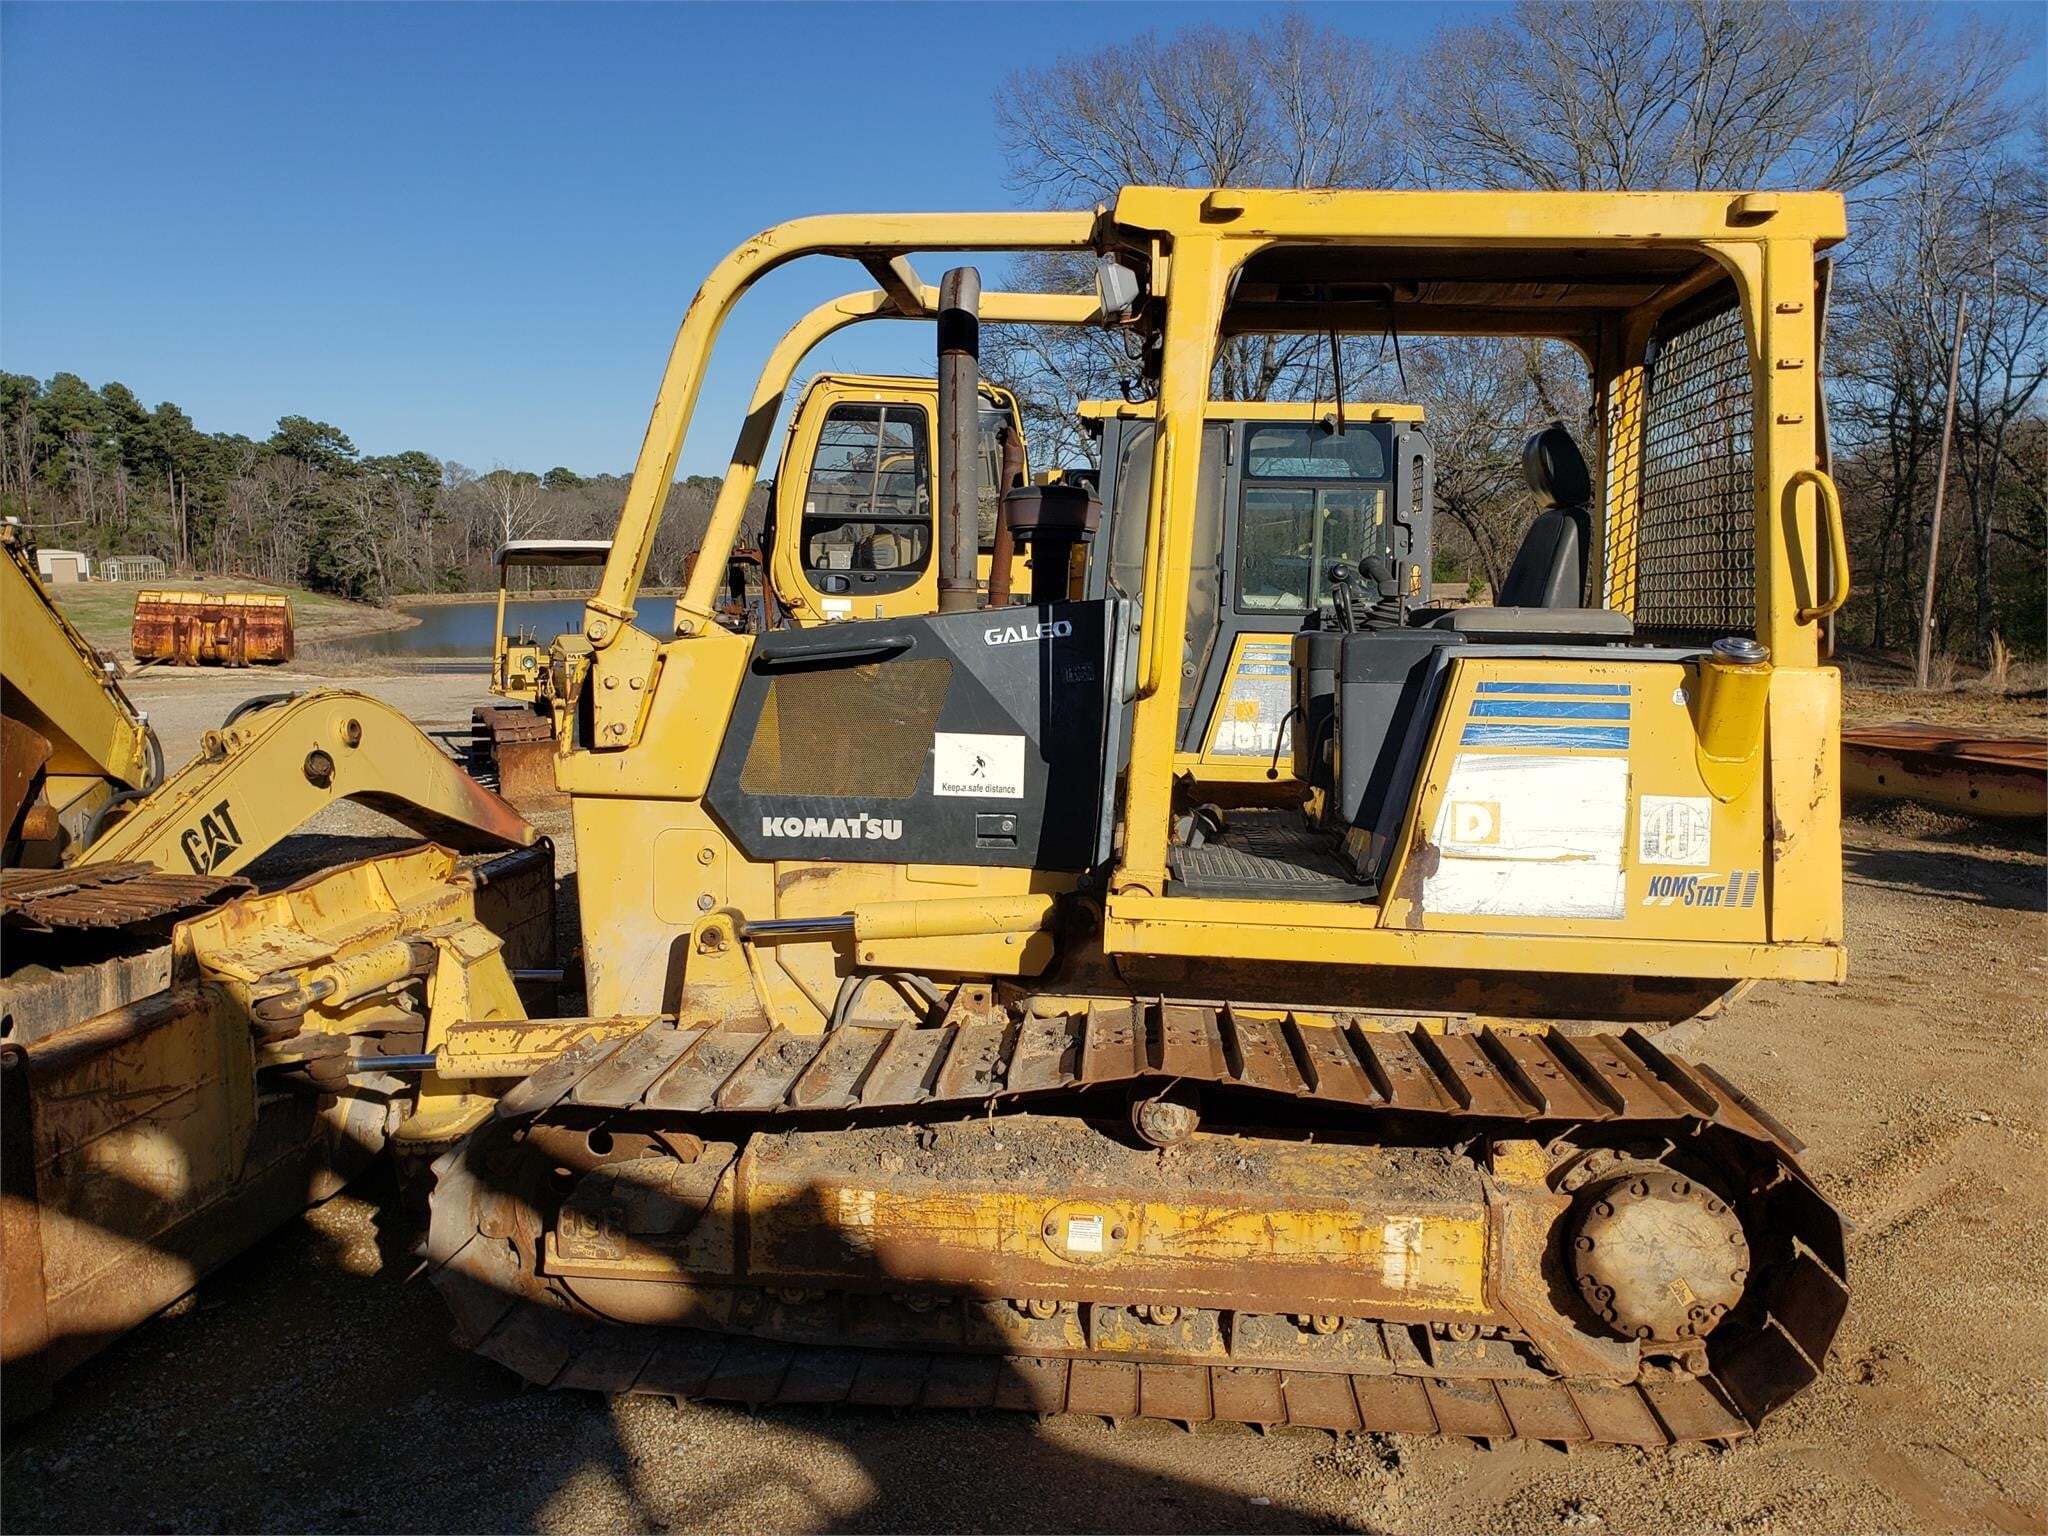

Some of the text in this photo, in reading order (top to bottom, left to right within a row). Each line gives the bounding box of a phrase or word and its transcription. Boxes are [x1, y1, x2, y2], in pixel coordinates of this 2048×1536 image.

[984, 621, 1072, 646] GALEO
[942, 783, 960, 793] Keep
[968, 784, 983, 792] safe
[985, 784, 1016, 793] distance
[762, 813, 903, 840] KOMATSU
[1455, 803, 1493, 842] D
[181, 799, 243, 876] CAT
